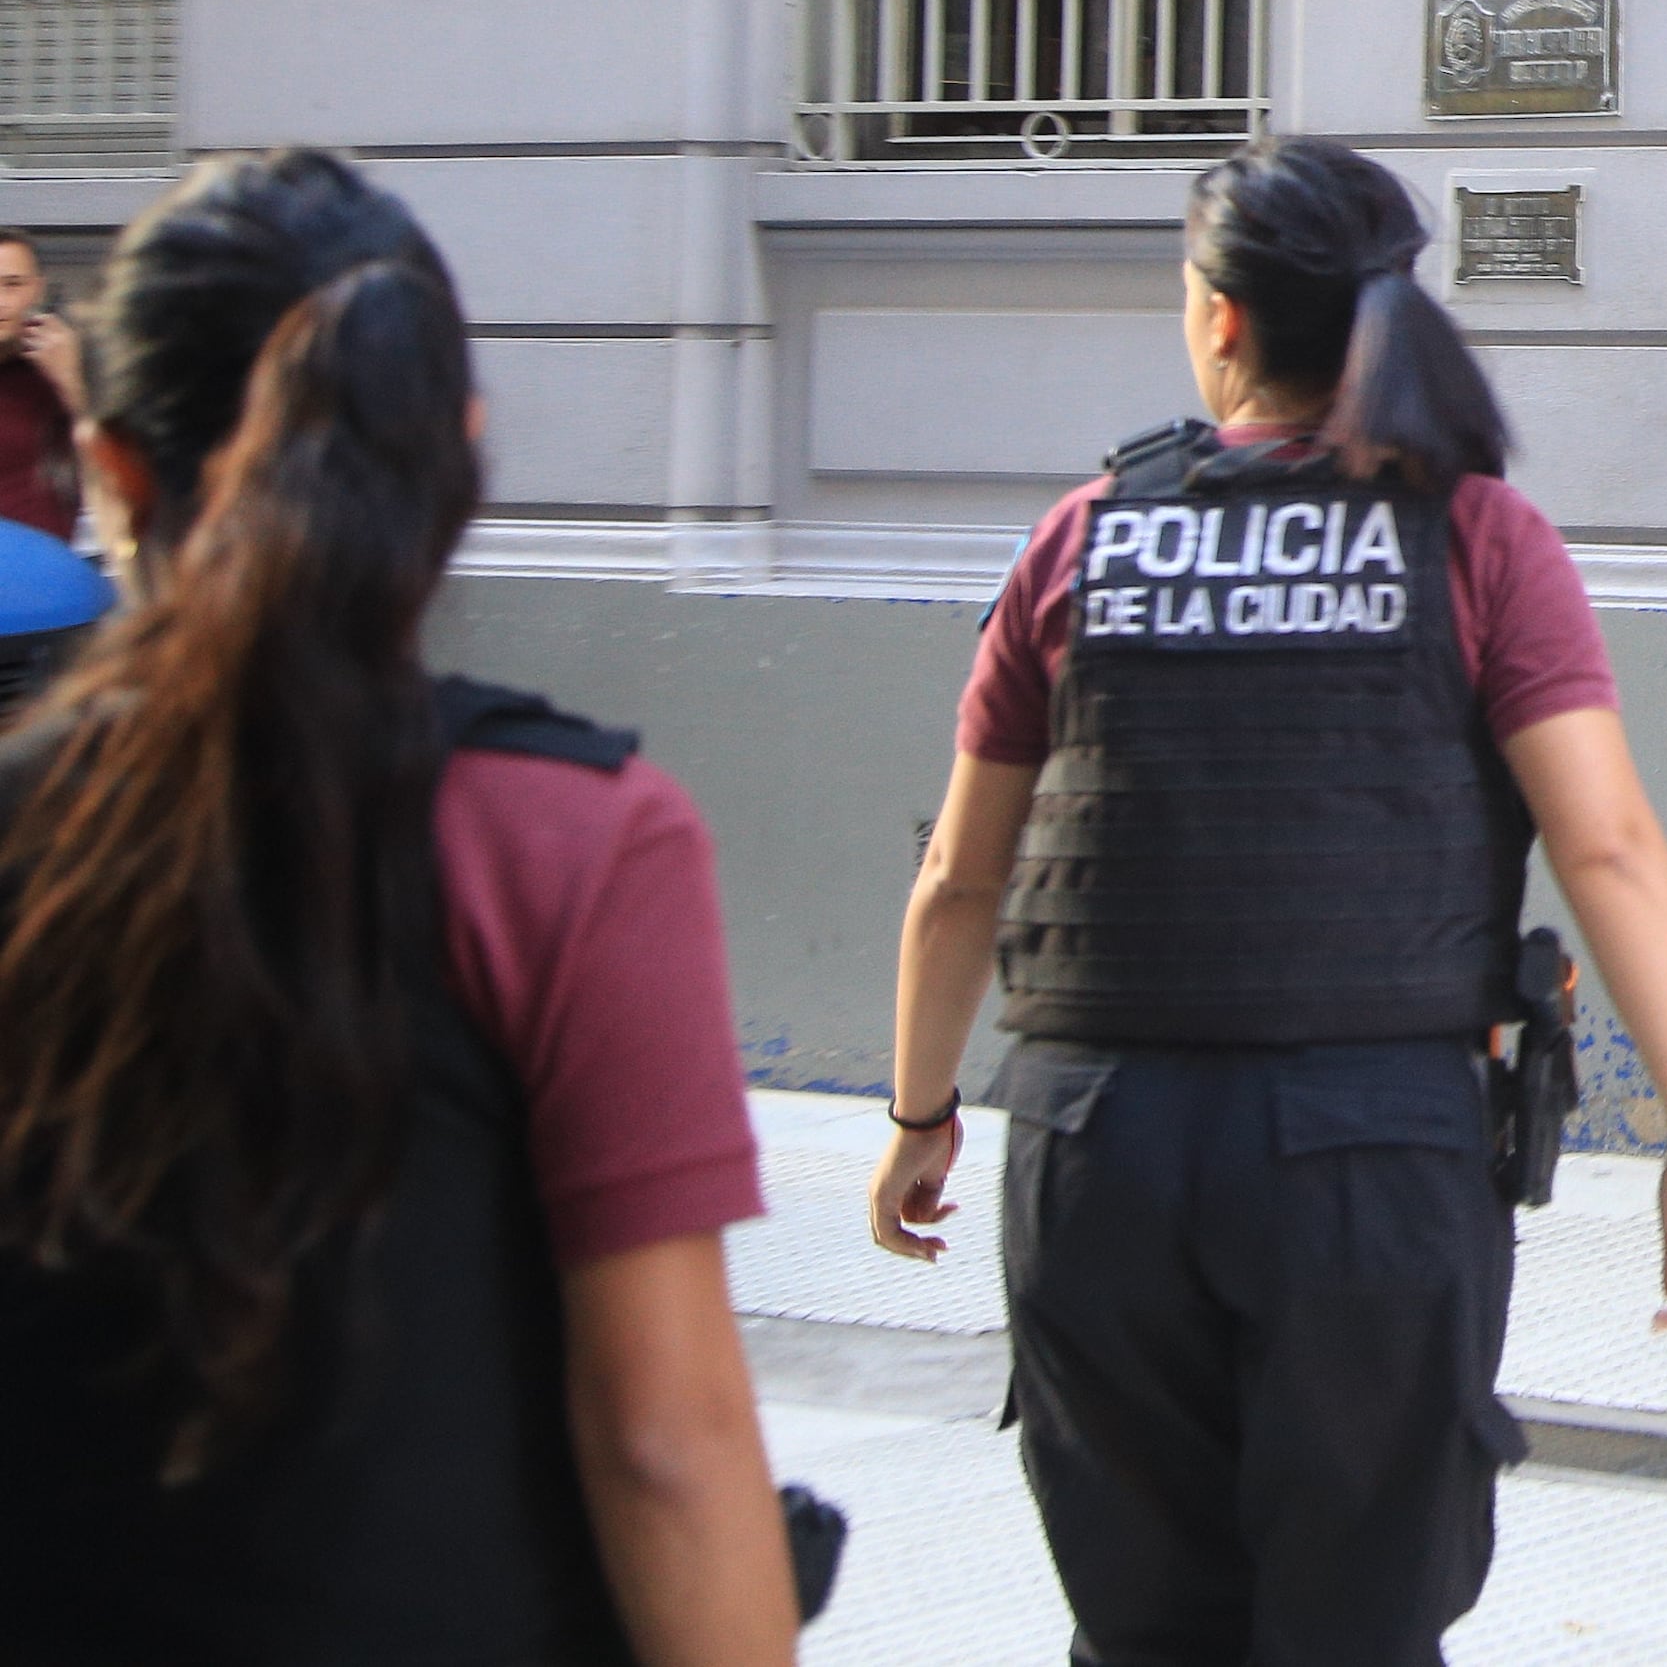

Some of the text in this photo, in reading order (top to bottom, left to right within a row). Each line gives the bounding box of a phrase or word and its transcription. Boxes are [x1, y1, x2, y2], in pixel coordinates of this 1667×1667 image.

[1087, 500, 1406, 581] POLICIA
[1085, 582, 1407, 636] DE LA CIUDAD
